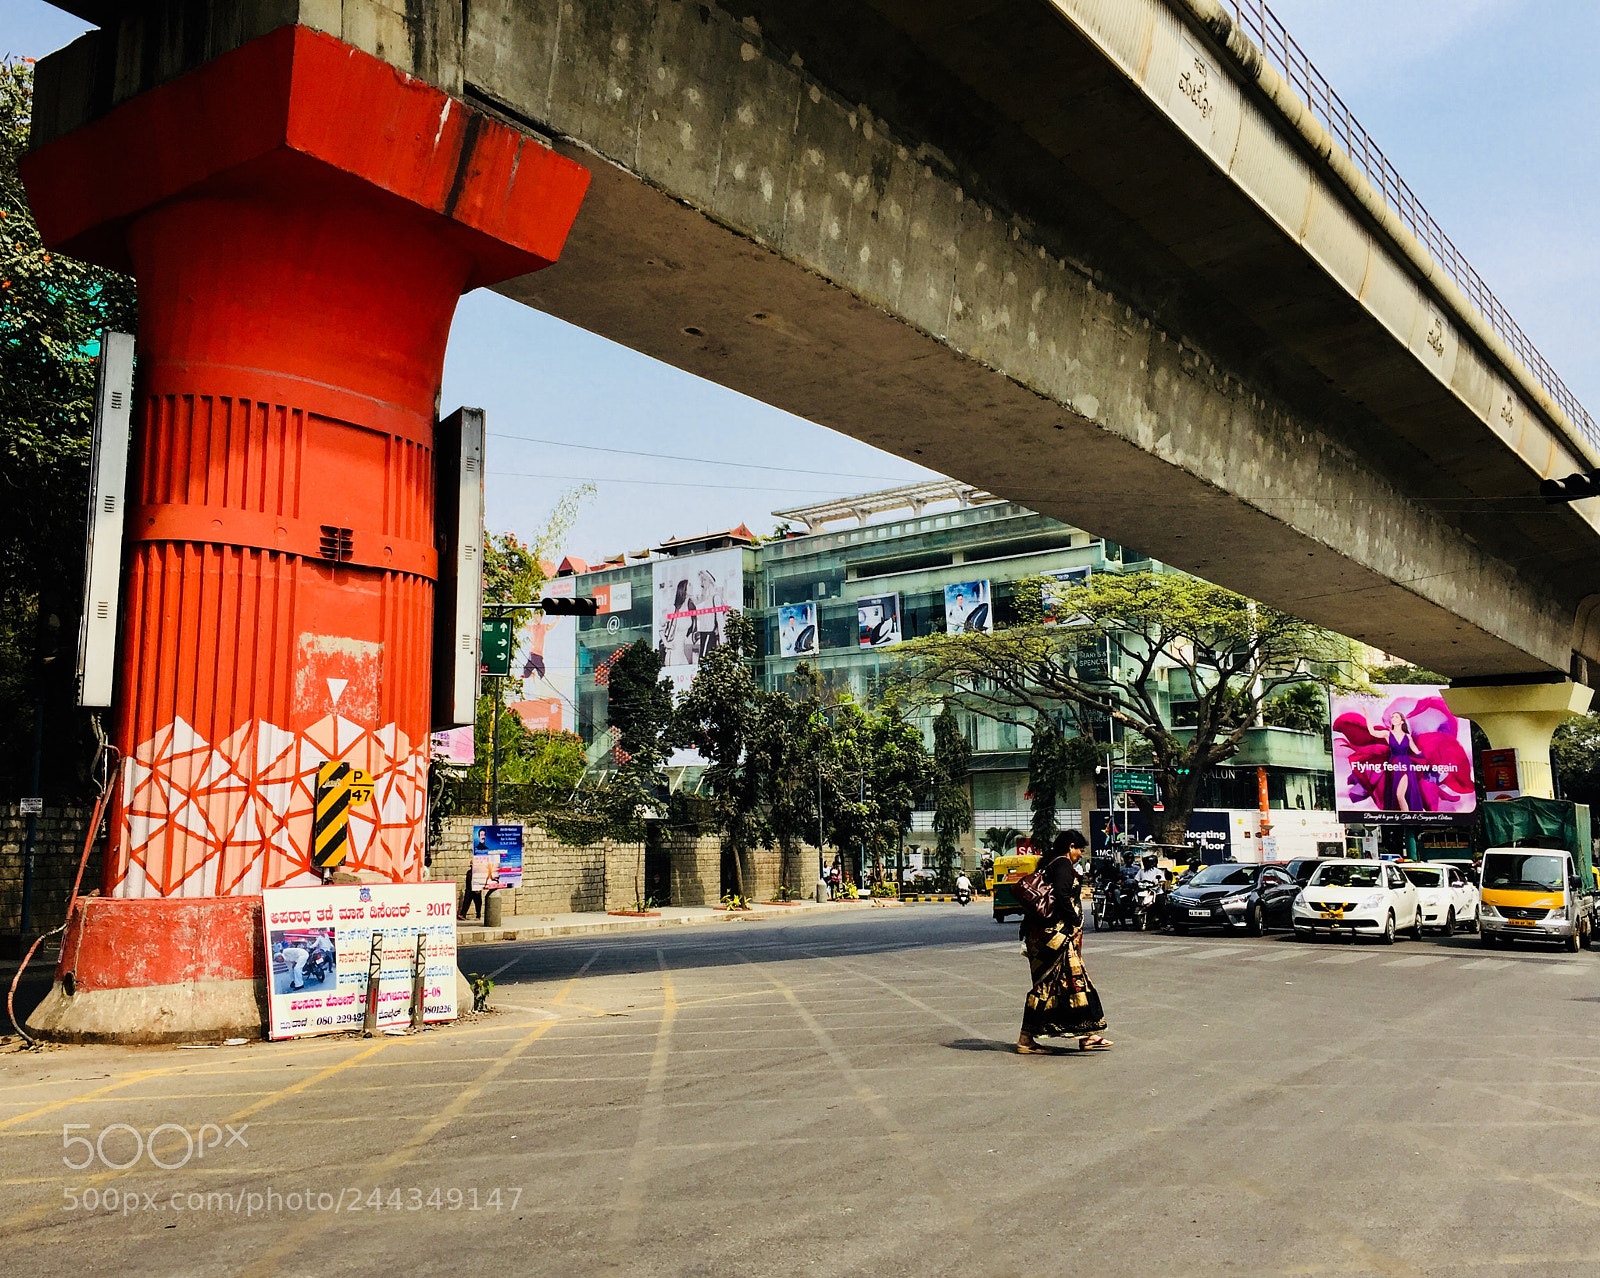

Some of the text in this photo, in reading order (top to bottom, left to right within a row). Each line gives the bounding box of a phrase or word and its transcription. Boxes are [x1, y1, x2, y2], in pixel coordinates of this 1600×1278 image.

[1351, 761, 1382, 773] Flying
[1383, 761, 1407, 771] feels
[1432, 763, 1458, 774] again
[353, 771, 363, 782] P
[351, 789, 371, 802] 47
[1185, 830, 1226, 840] locating
[426, 902, 452, 917] 2017
[316, 1016, 333, 1026] 080
